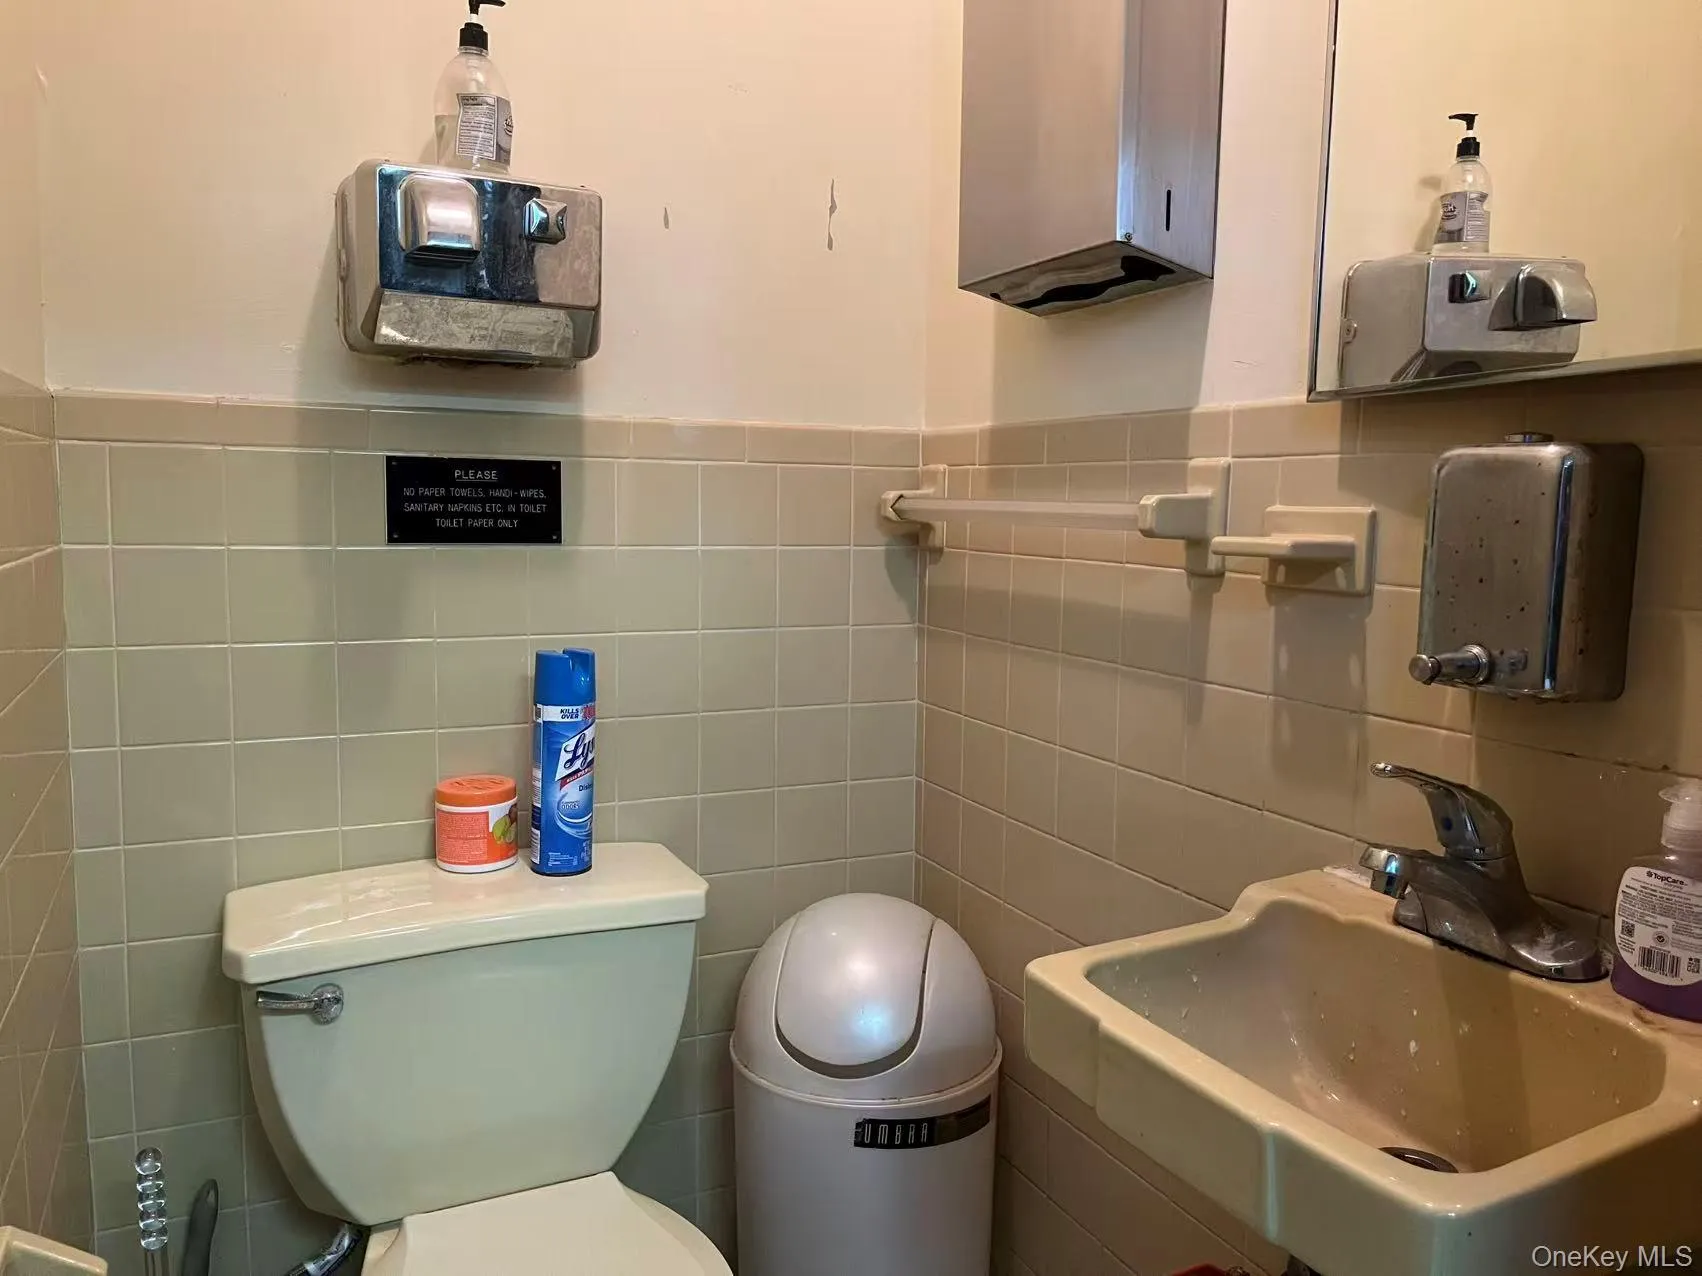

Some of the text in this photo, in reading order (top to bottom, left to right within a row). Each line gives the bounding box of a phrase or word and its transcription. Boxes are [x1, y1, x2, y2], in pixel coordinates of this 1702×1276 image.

[454, 469, 499, 480] PLEASE
[403, 487, 415, 496] NO
[418, 487, 446, 497] PAPER
[403, 502, 444, 512] SANITARY
[447, 503, 483, 513] NAPKINS
[507, 504, 516, 513] IN
[519, 504, 548, 513] TOILET
[435, 518, 519, 528] TOILET PAPER ONLY
[1652, 872, 1685, 886] TopCare
